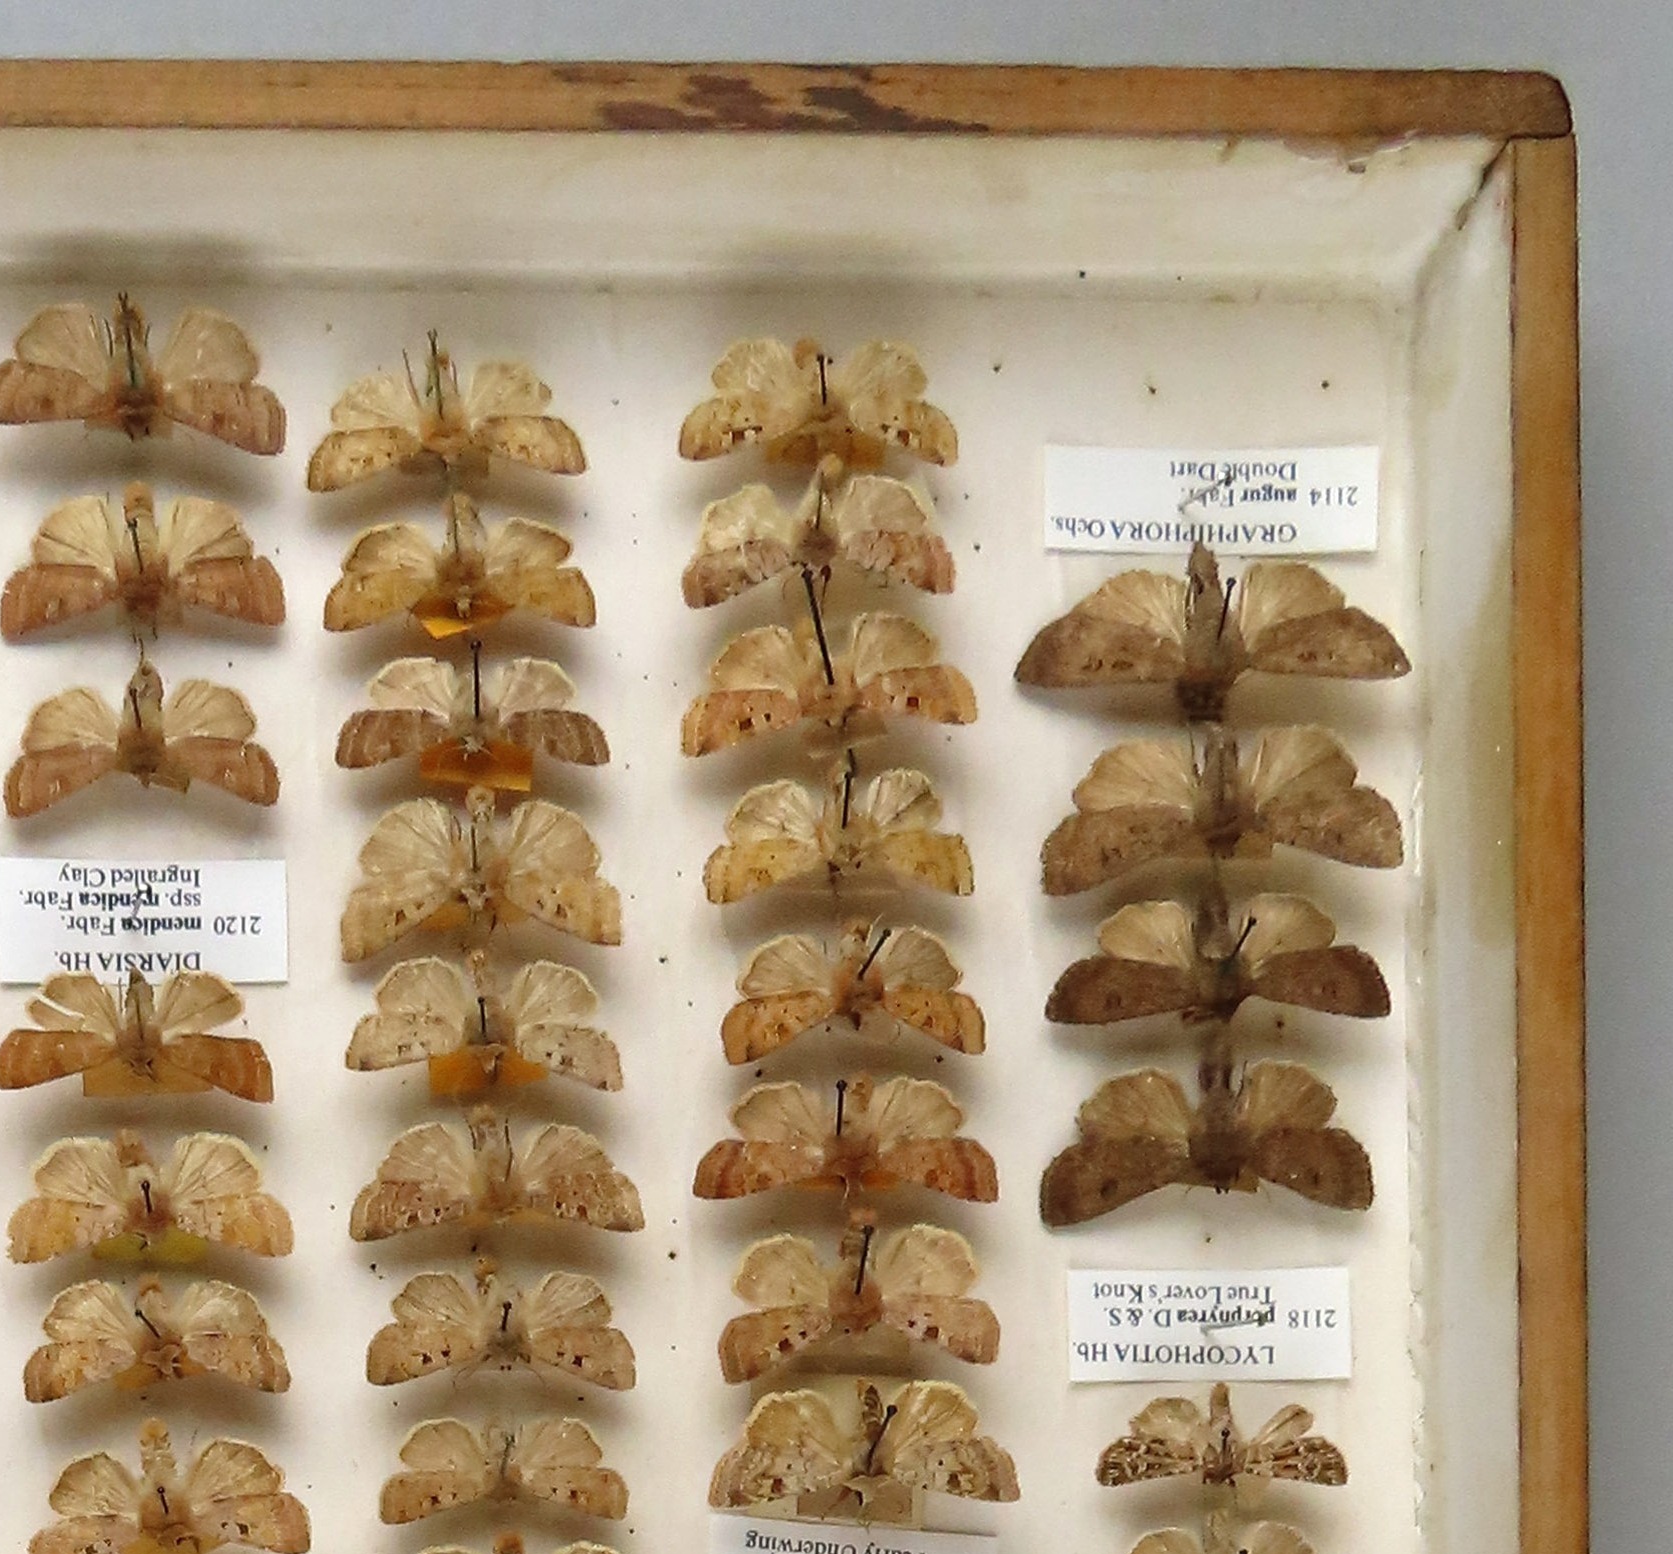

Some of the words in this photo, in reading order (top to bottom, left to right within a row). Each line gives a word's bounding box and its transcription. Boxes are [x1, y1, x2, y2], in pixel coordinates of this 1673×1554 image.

[1170, 461, 1216, 480] Dart
[1240, 486, 1297, 505] augur
[1310, 487, 1358, 506] 2114
[1051, 517, 1104, 539] Ochs.
[1110, 522, 1297, 543] GRAPHIPHORA
[59, 864, 105, 886] Clay
[111, 866, 201, 886] Ingrailed
[19, 891, 73, 909] Fabr.
[164, 890, 201, 908] ssp.
[60, 916, 115, 935] Fabr.
[121, 917, 201, 935] mendica
[214, 916, 261, 934] 2120
[54, 952, 91, 972] Hb.
[97, 952, 201, 972] DIARSIA
[1093, 1283, 1143, 1304] Knot
[1227, 1287, 1274, 1304] True
[1103, 1308, 1120, 1326] S.
[1125, 1308, 1143, 1326] &
[1148, 1309, 1171, 1326] D.
[1288, 1309, 1337, 1327] 2118
[1073, 1342, 1108, 1362] Hb.
[1114, 1345, 1274, 1364] LYCOPHOTIA
